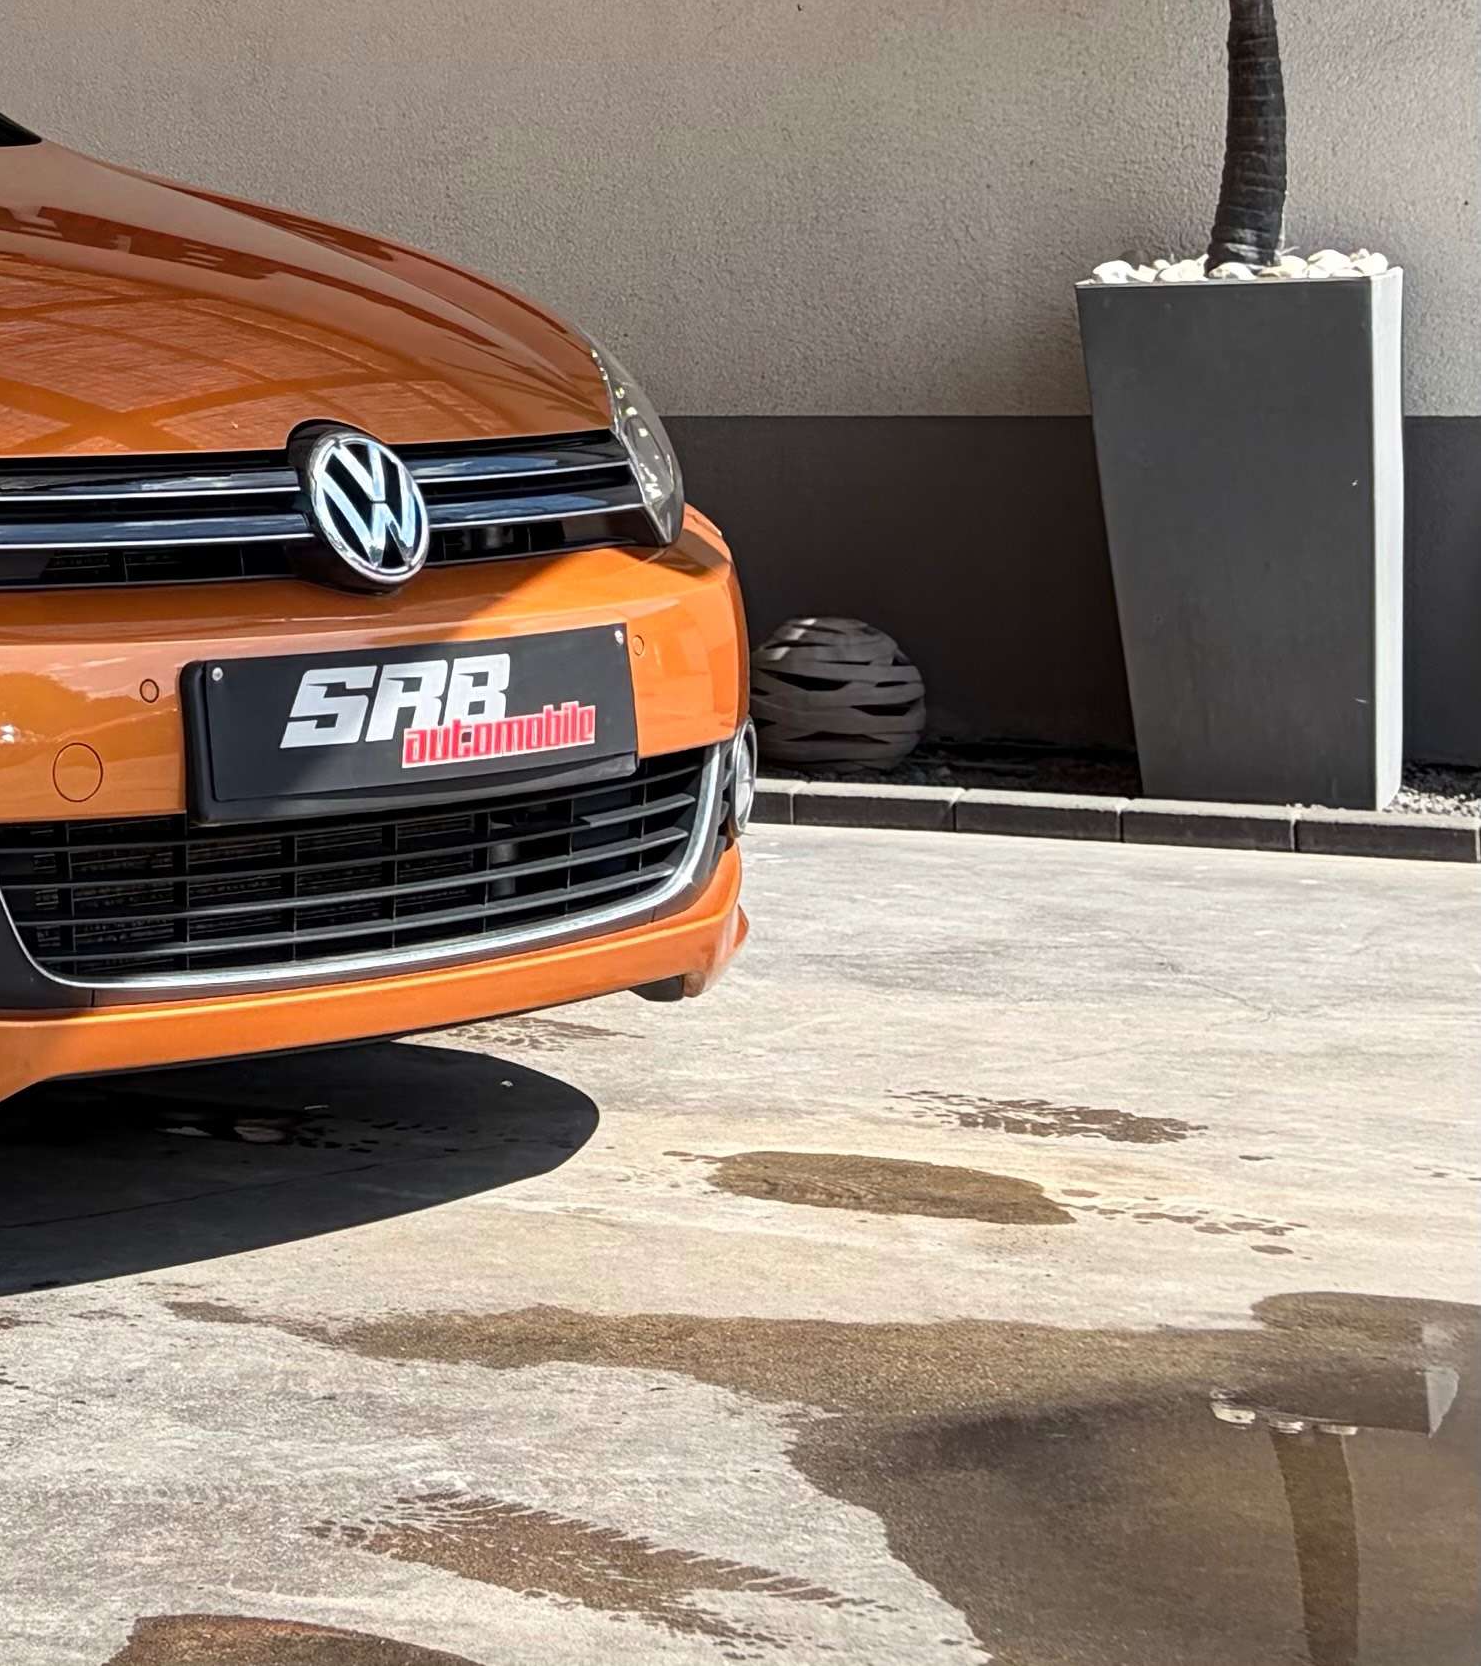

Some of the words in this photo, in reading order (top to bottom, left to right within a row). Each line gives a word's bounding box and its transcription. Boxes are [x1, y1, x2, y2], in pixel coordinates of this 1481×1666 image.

[314, 438, 423, 576] VW
[280, 654, 510, 748] SRB
[402, 701, 595, 768] automobile
